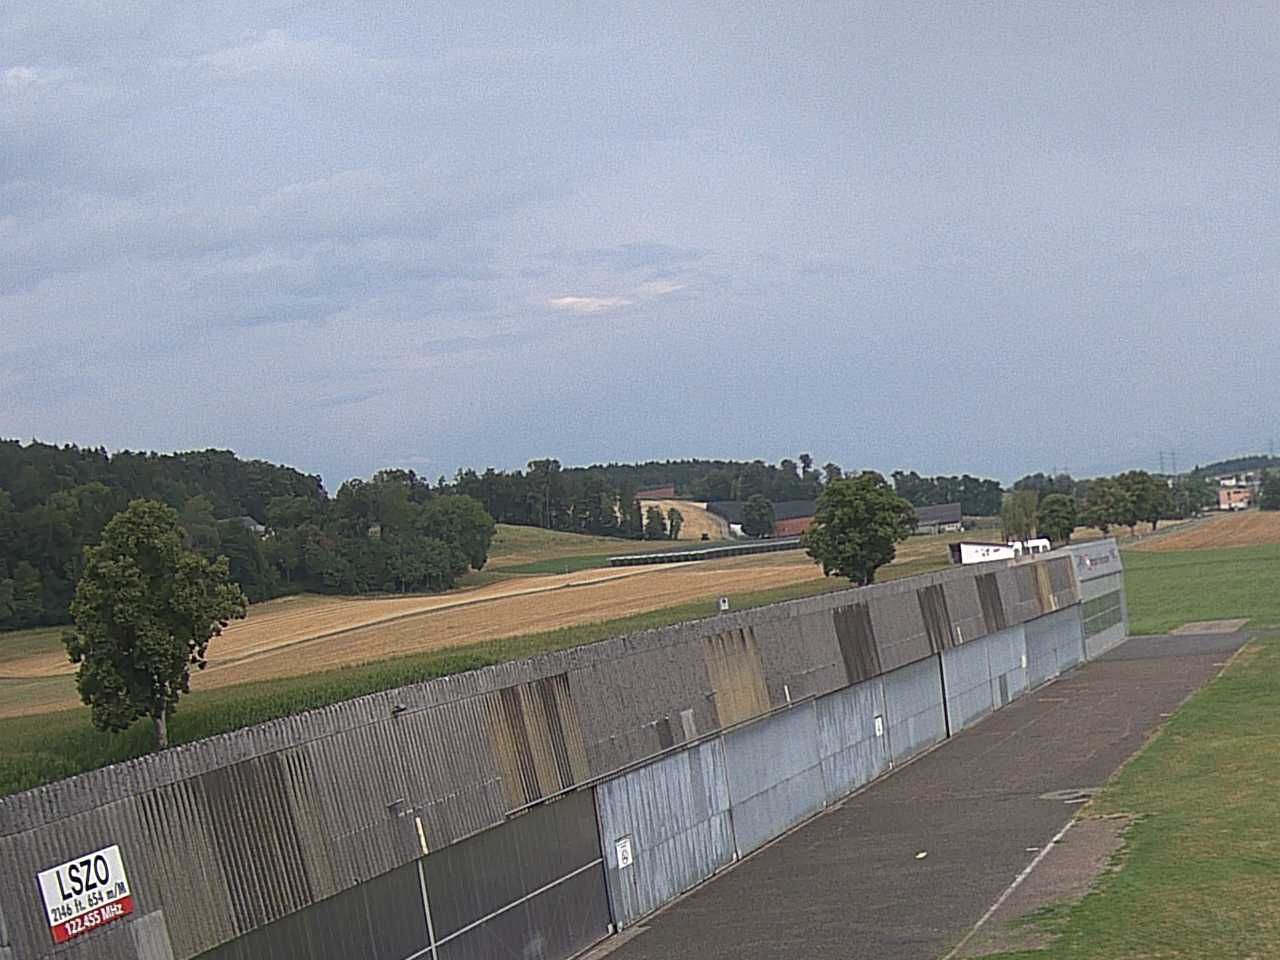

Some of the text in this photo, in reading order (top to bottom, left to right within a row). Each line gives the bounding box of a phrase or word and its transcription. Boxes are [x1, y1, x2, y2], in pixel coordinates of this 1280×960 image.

[56, 854, 109, 900] LSZO
[51, 903, 72, 922] 2146
[87, 890, 104, 907] 654
[65, 903, 124, 935] 122.455 MHz
